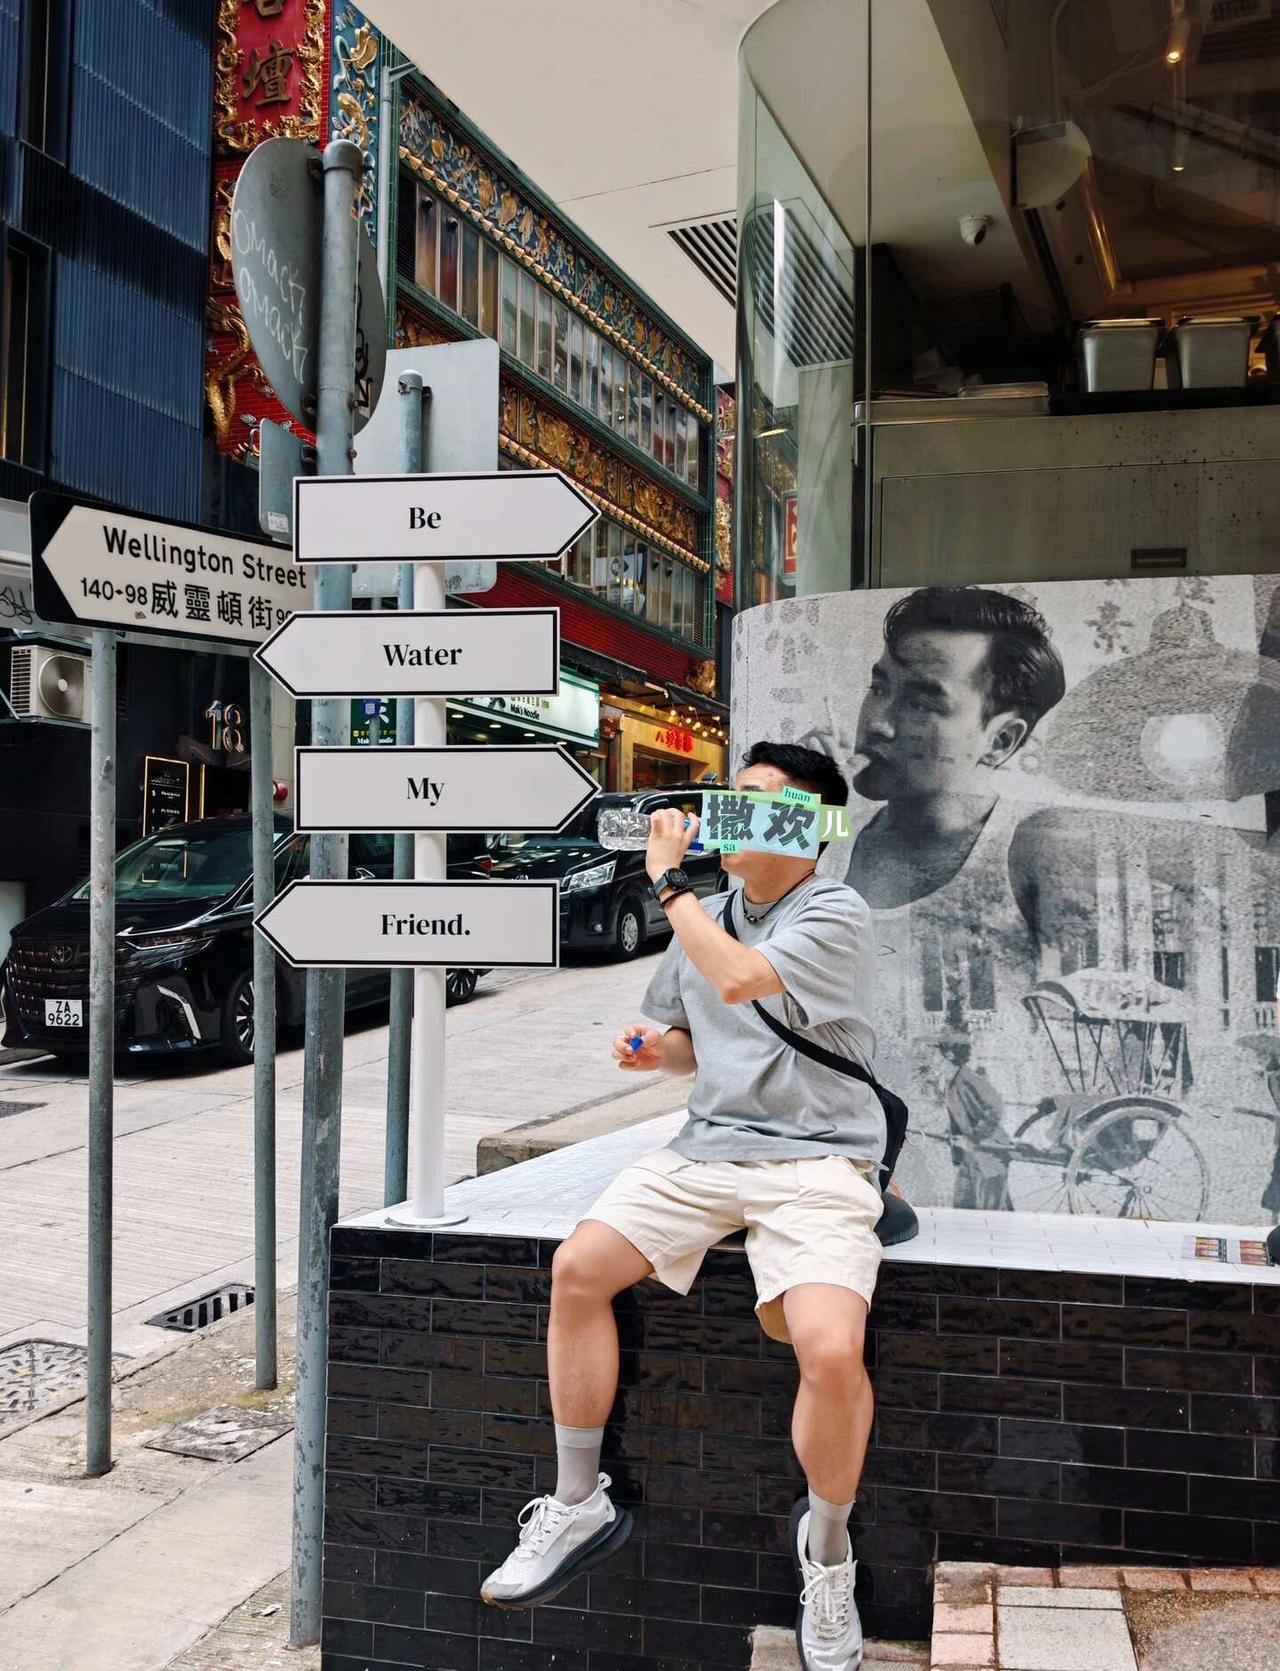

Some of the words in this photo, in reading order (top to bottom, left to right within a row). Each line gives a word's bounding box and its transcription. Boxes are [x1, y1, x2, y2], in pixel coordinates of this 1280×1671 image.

[408, 506, 442, 530] Be
[103, 525, 233, 575] Wellington
[242, 553, 307, 589] Street
[151, 579, 273, 631] 威靈頓街
[382, 643, 463, 667] Water
[406, 777, 445, 807] My
[381, 913, 471, 936] Friend.
[55, 1000, 71, 1013] ZA
[48, 1013, 80, 1026] 9622
